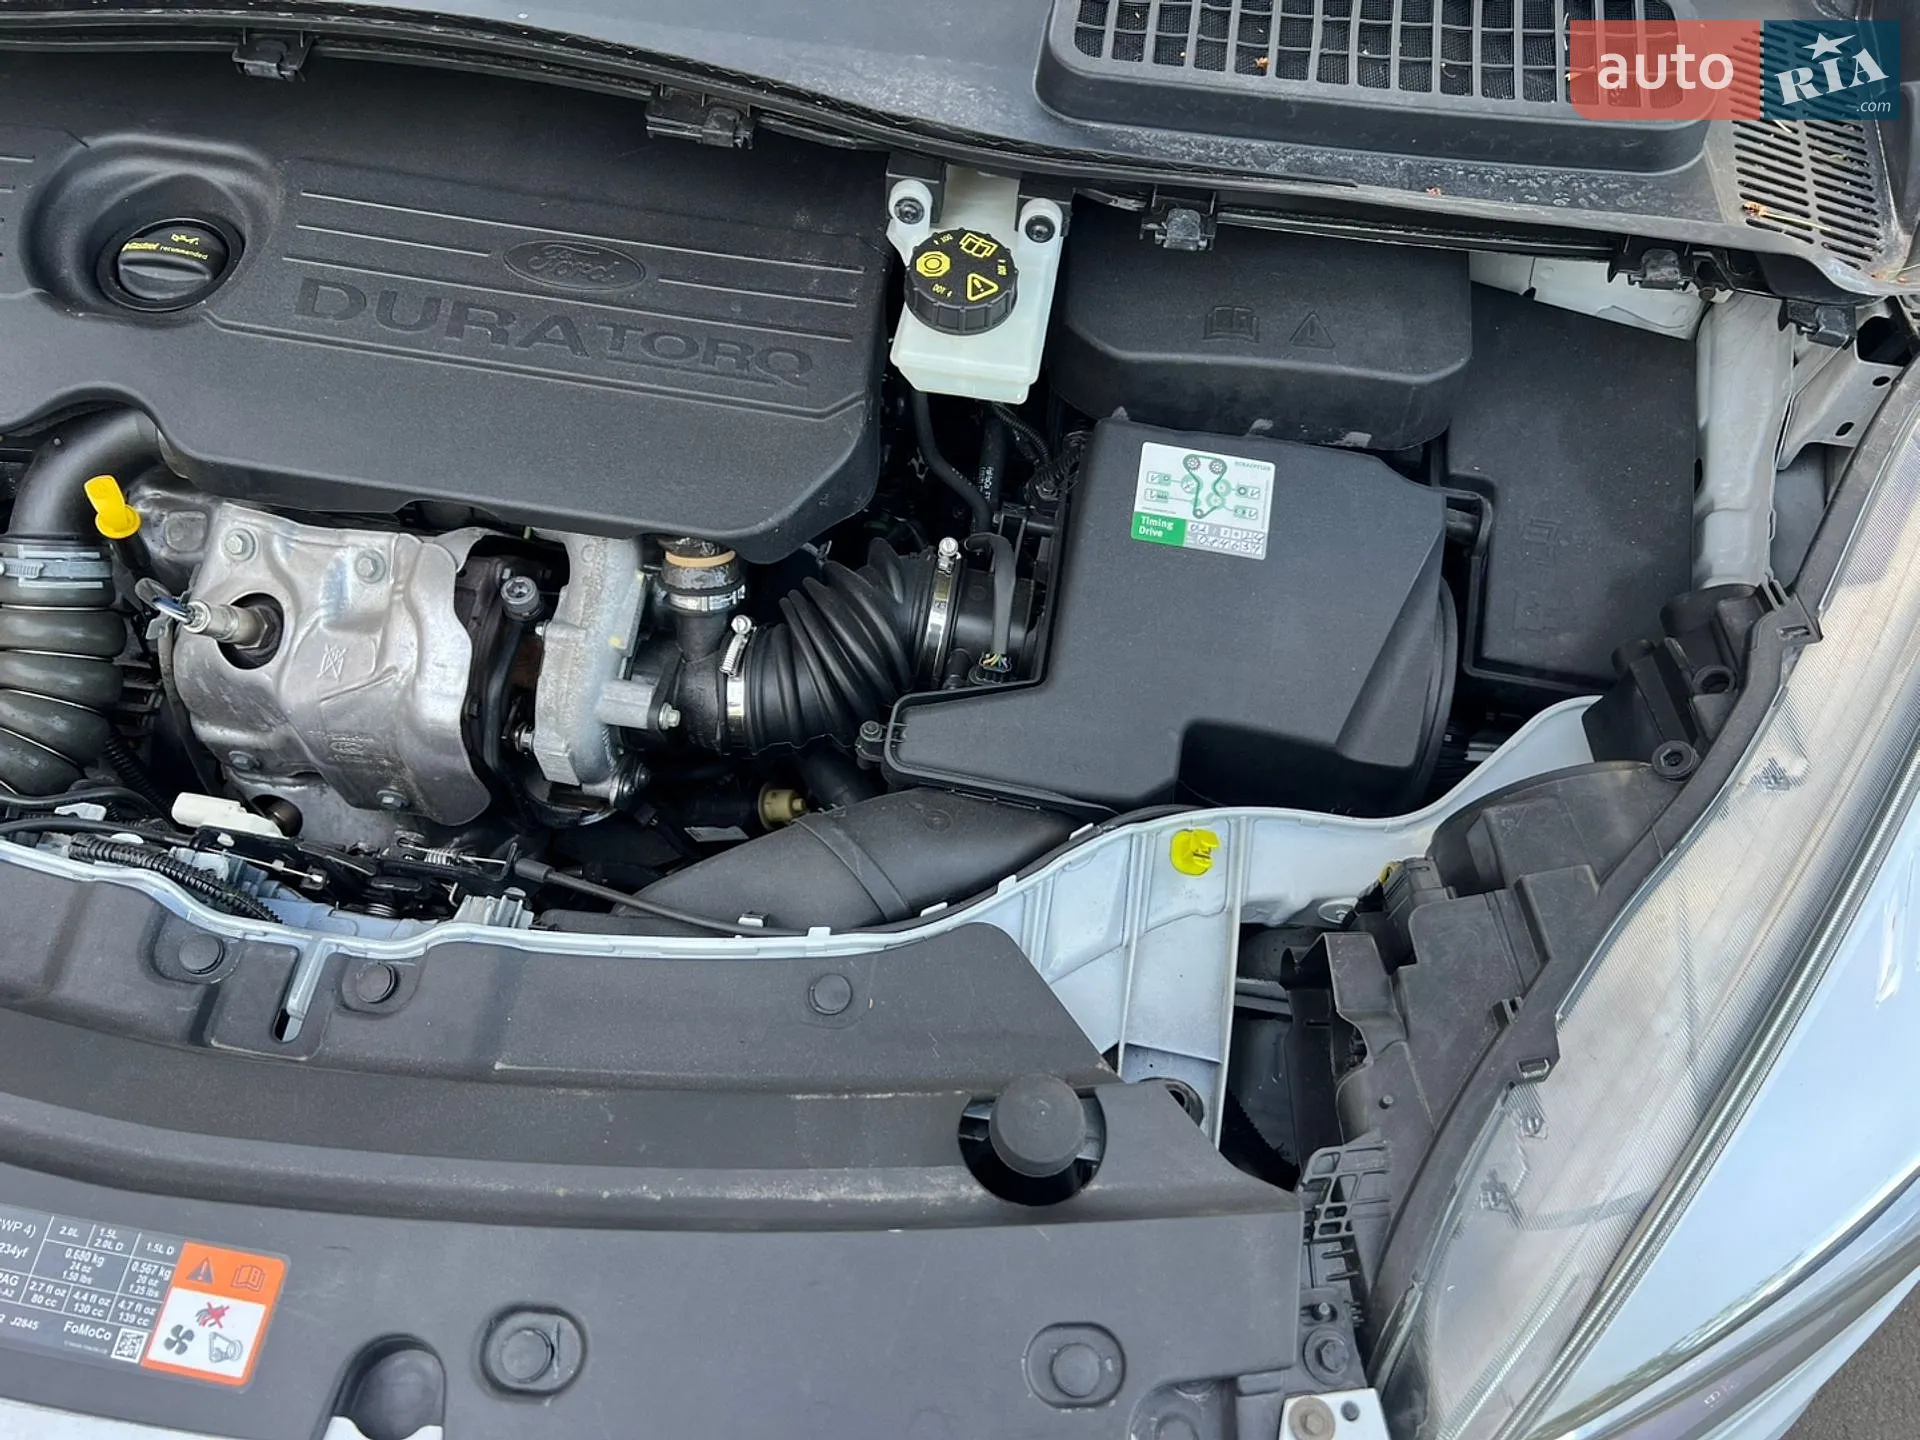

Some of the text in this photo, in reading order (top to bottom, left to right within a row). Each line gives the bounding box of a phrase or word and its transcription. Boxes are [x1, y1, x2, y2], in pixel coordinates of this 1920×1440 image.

[528, 243, 620, 282] Ford
[1141, 515, 1174, 531] Timing
[1138, 525, 1164, 537] Drive
[92, 1253, 105, 1268] kg
[158, 1266, 172, 1281] kg
[29, 1281, 67, 1297] 2.7 fl oz
[148, 1278, 159, 1287] oz
[45, 1298, 57, 1307] cc
[73, 1291, 111, 1307] 4.4 fl oz
[74, 1302, 105, 1317] 130 cc
[117, 1300, 157, 1316] 4.7 fl oz
[119, 1312, 150, 1327] 139 cc
[63, 1320, 112, 1341] FoMoCo
